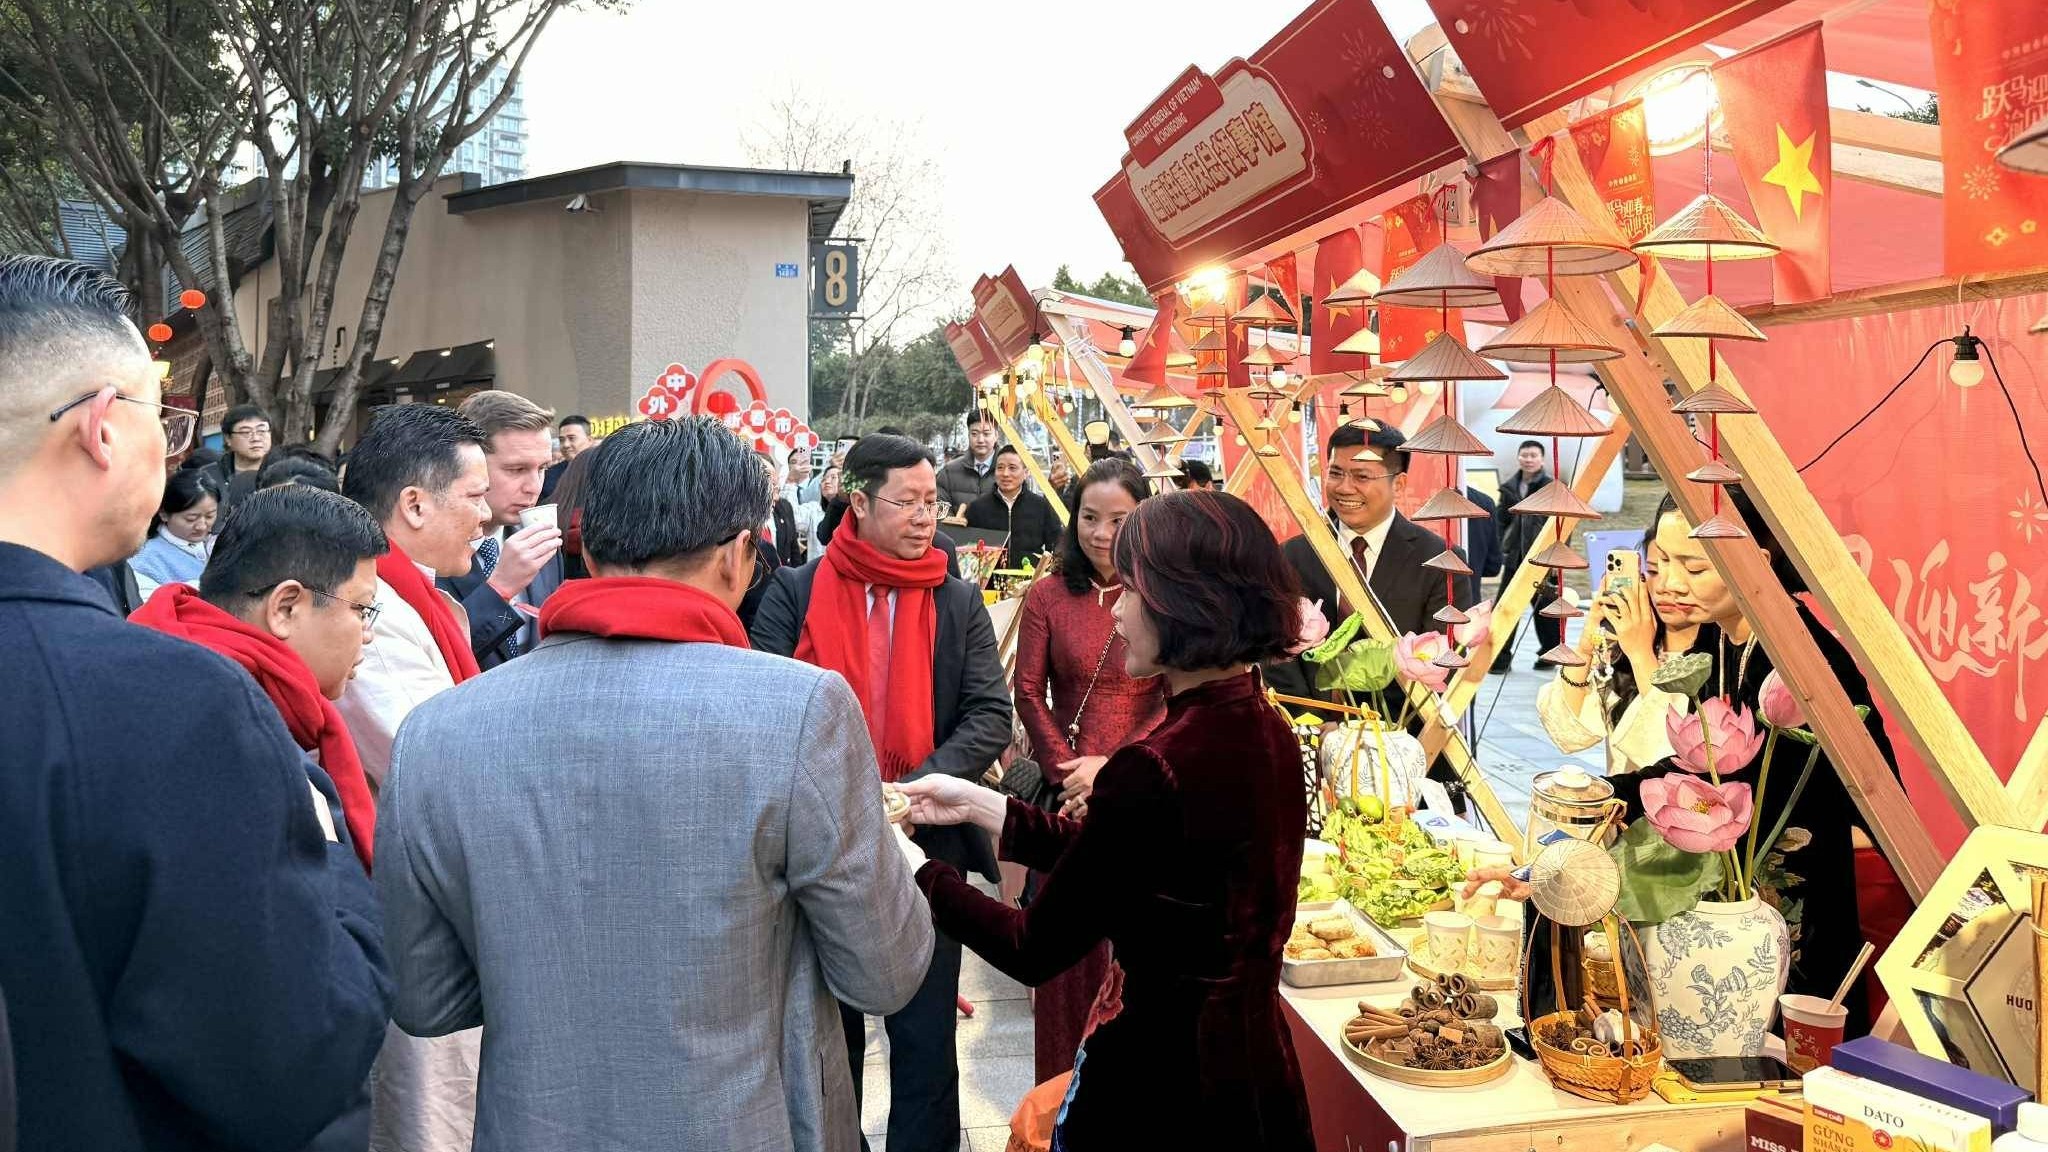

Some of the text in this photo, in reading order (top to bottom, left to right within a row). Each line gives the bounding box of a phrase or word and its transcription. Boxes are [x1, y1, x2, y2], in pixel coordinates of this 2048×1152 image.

[1150, 104, 1172, 128] GENERAL
[1175, 75, 1203, 105] VIETNAM
[825, 251, 848, 306] 8
[1864, 1105, 1905, 1129] DATO
[1750, 1135, 1787, 1152] MISS
